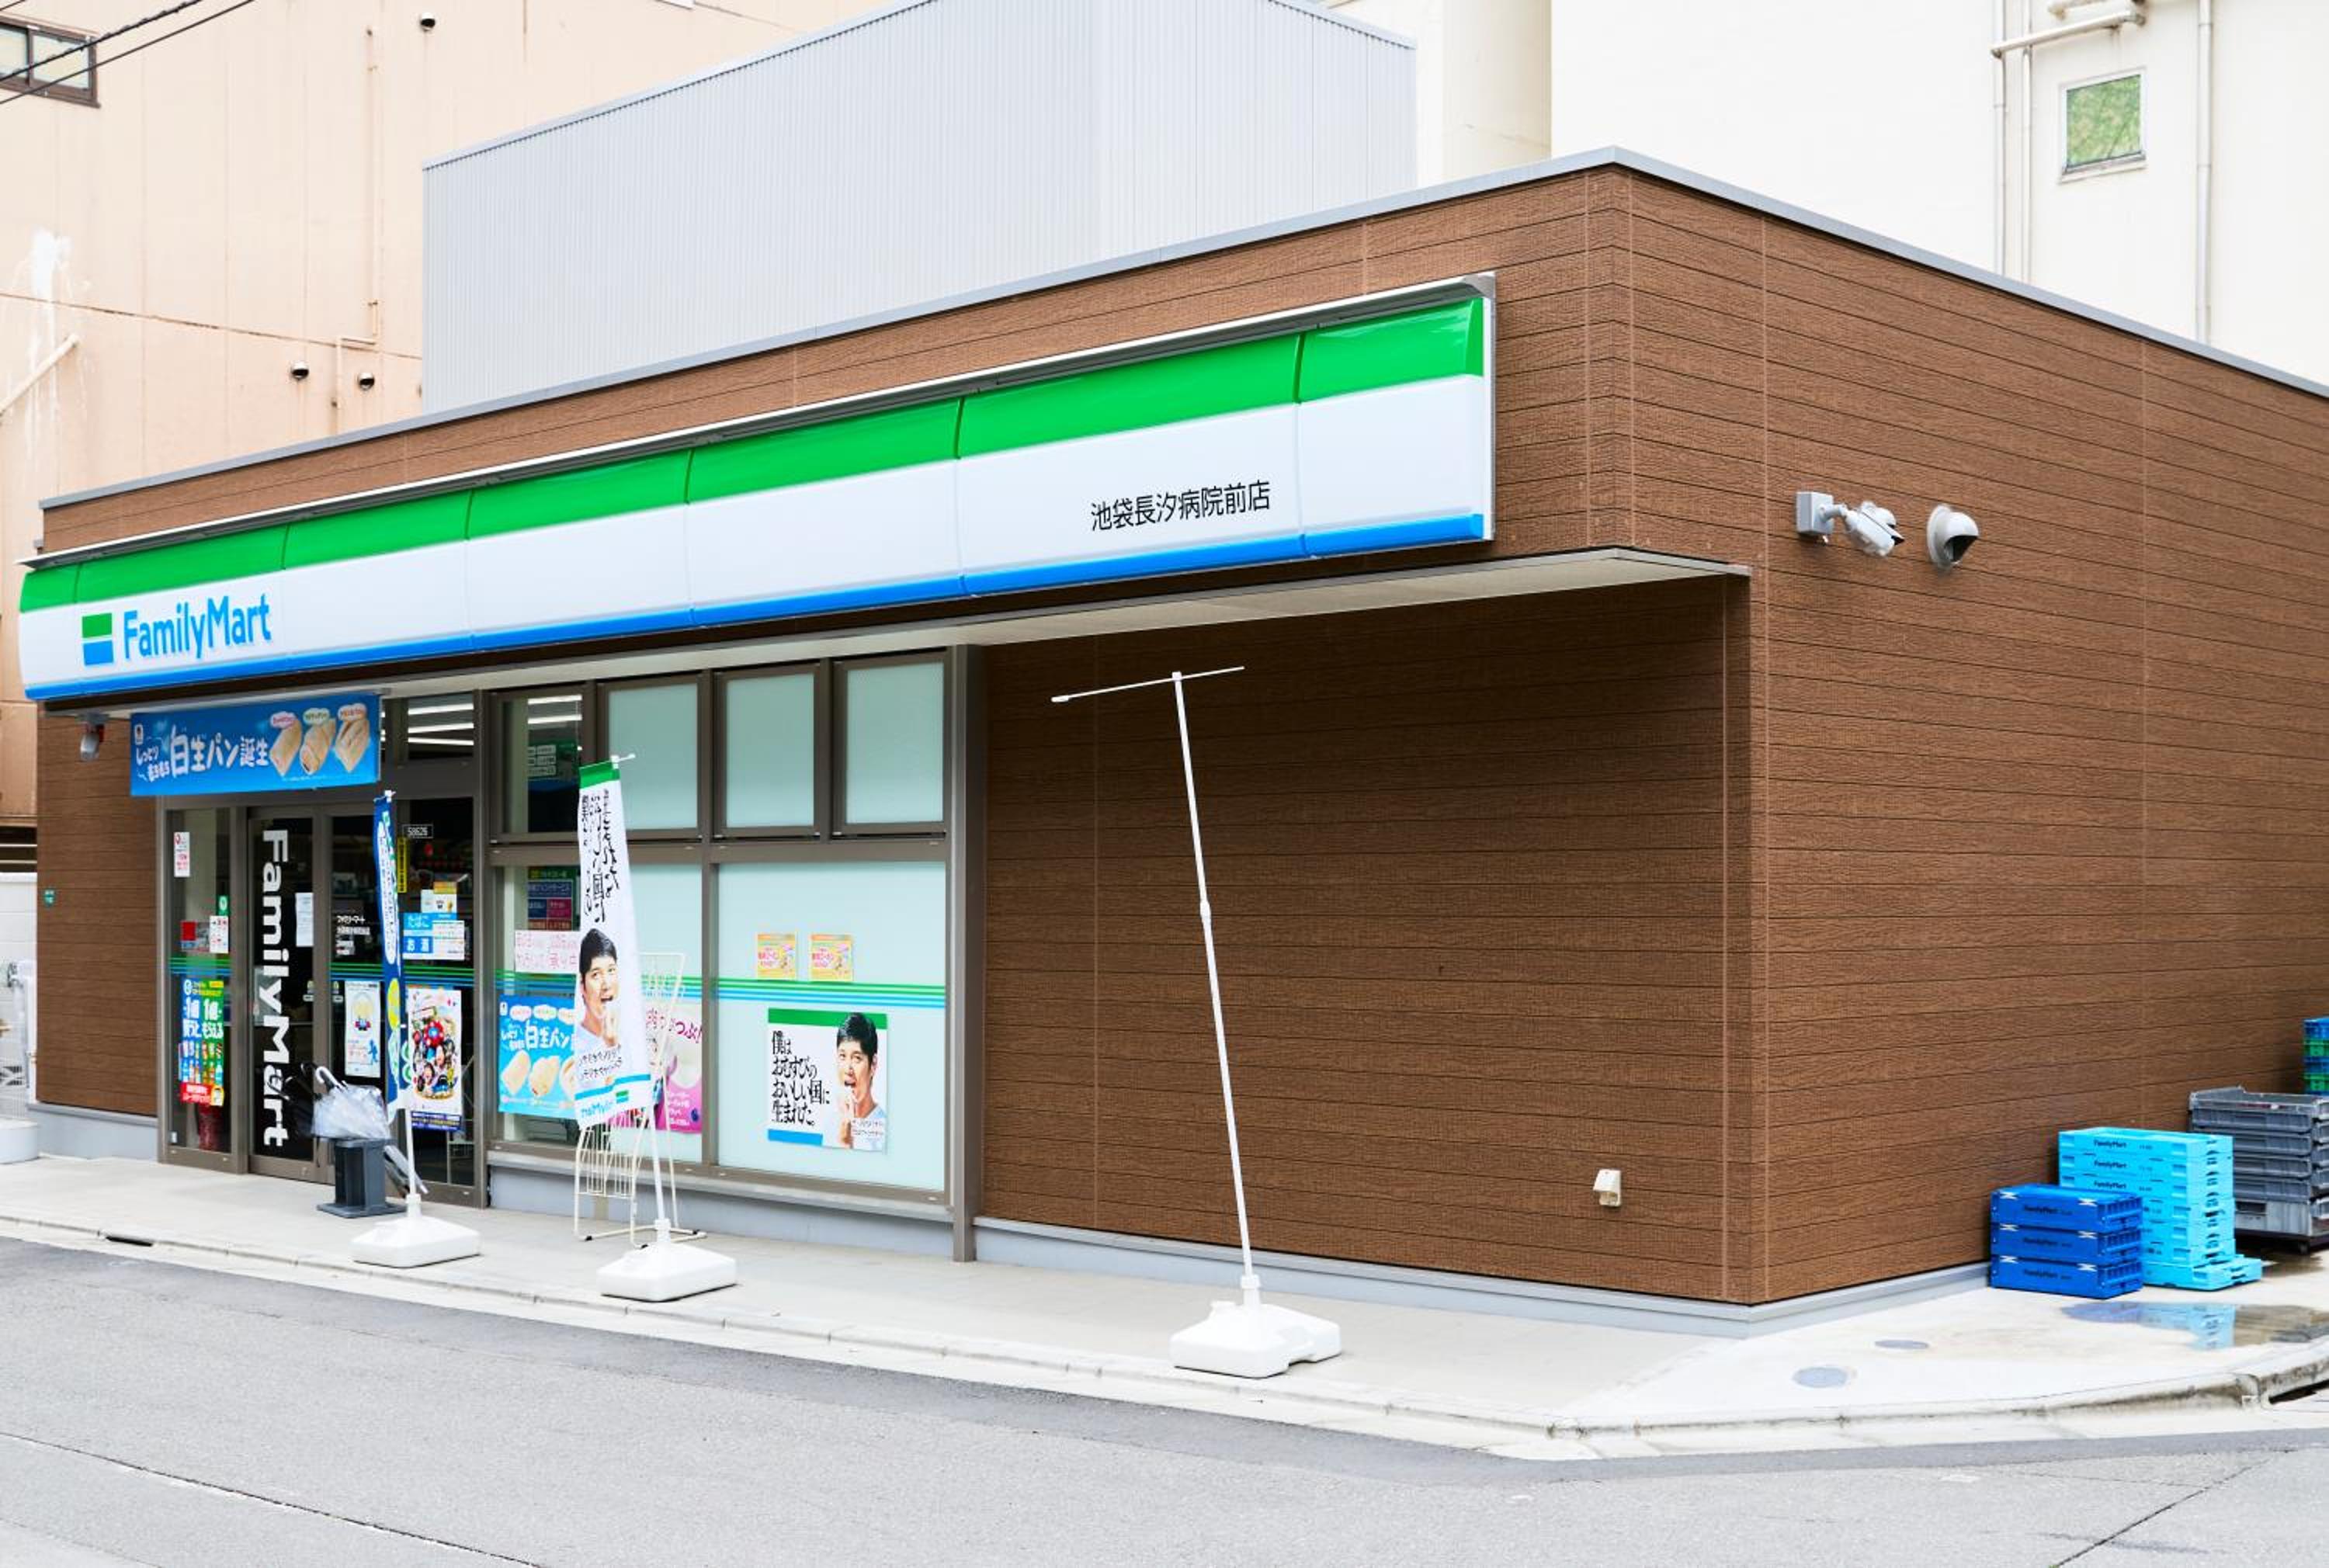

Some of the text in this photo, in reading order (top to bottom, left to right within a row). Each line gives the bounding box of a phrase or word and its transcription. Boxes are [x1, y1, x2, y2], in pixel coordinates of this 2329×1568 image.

[1091, 479, 1271, 531] 池袋長汐病院前店
[123, 593, 272, 659] FamilyMart
[170, 724, 269, 779] 白生パン誕生
[259, 829, 290, 1147] FamilyMart
[772, 1029, 793, 1055] 僕は
[771, 1055, 818, 1080] おむすびの
[771, 1079, 831, 1105] おいしい国に
[771, 1098, 816, 1126] 生まれた。
[2095, 1139, 2127, 1148] FamilyMart
[2095, 1160, 2127, 1169] FamilyMart
[2095, 1181, 2127, 1190] FamilyMart
